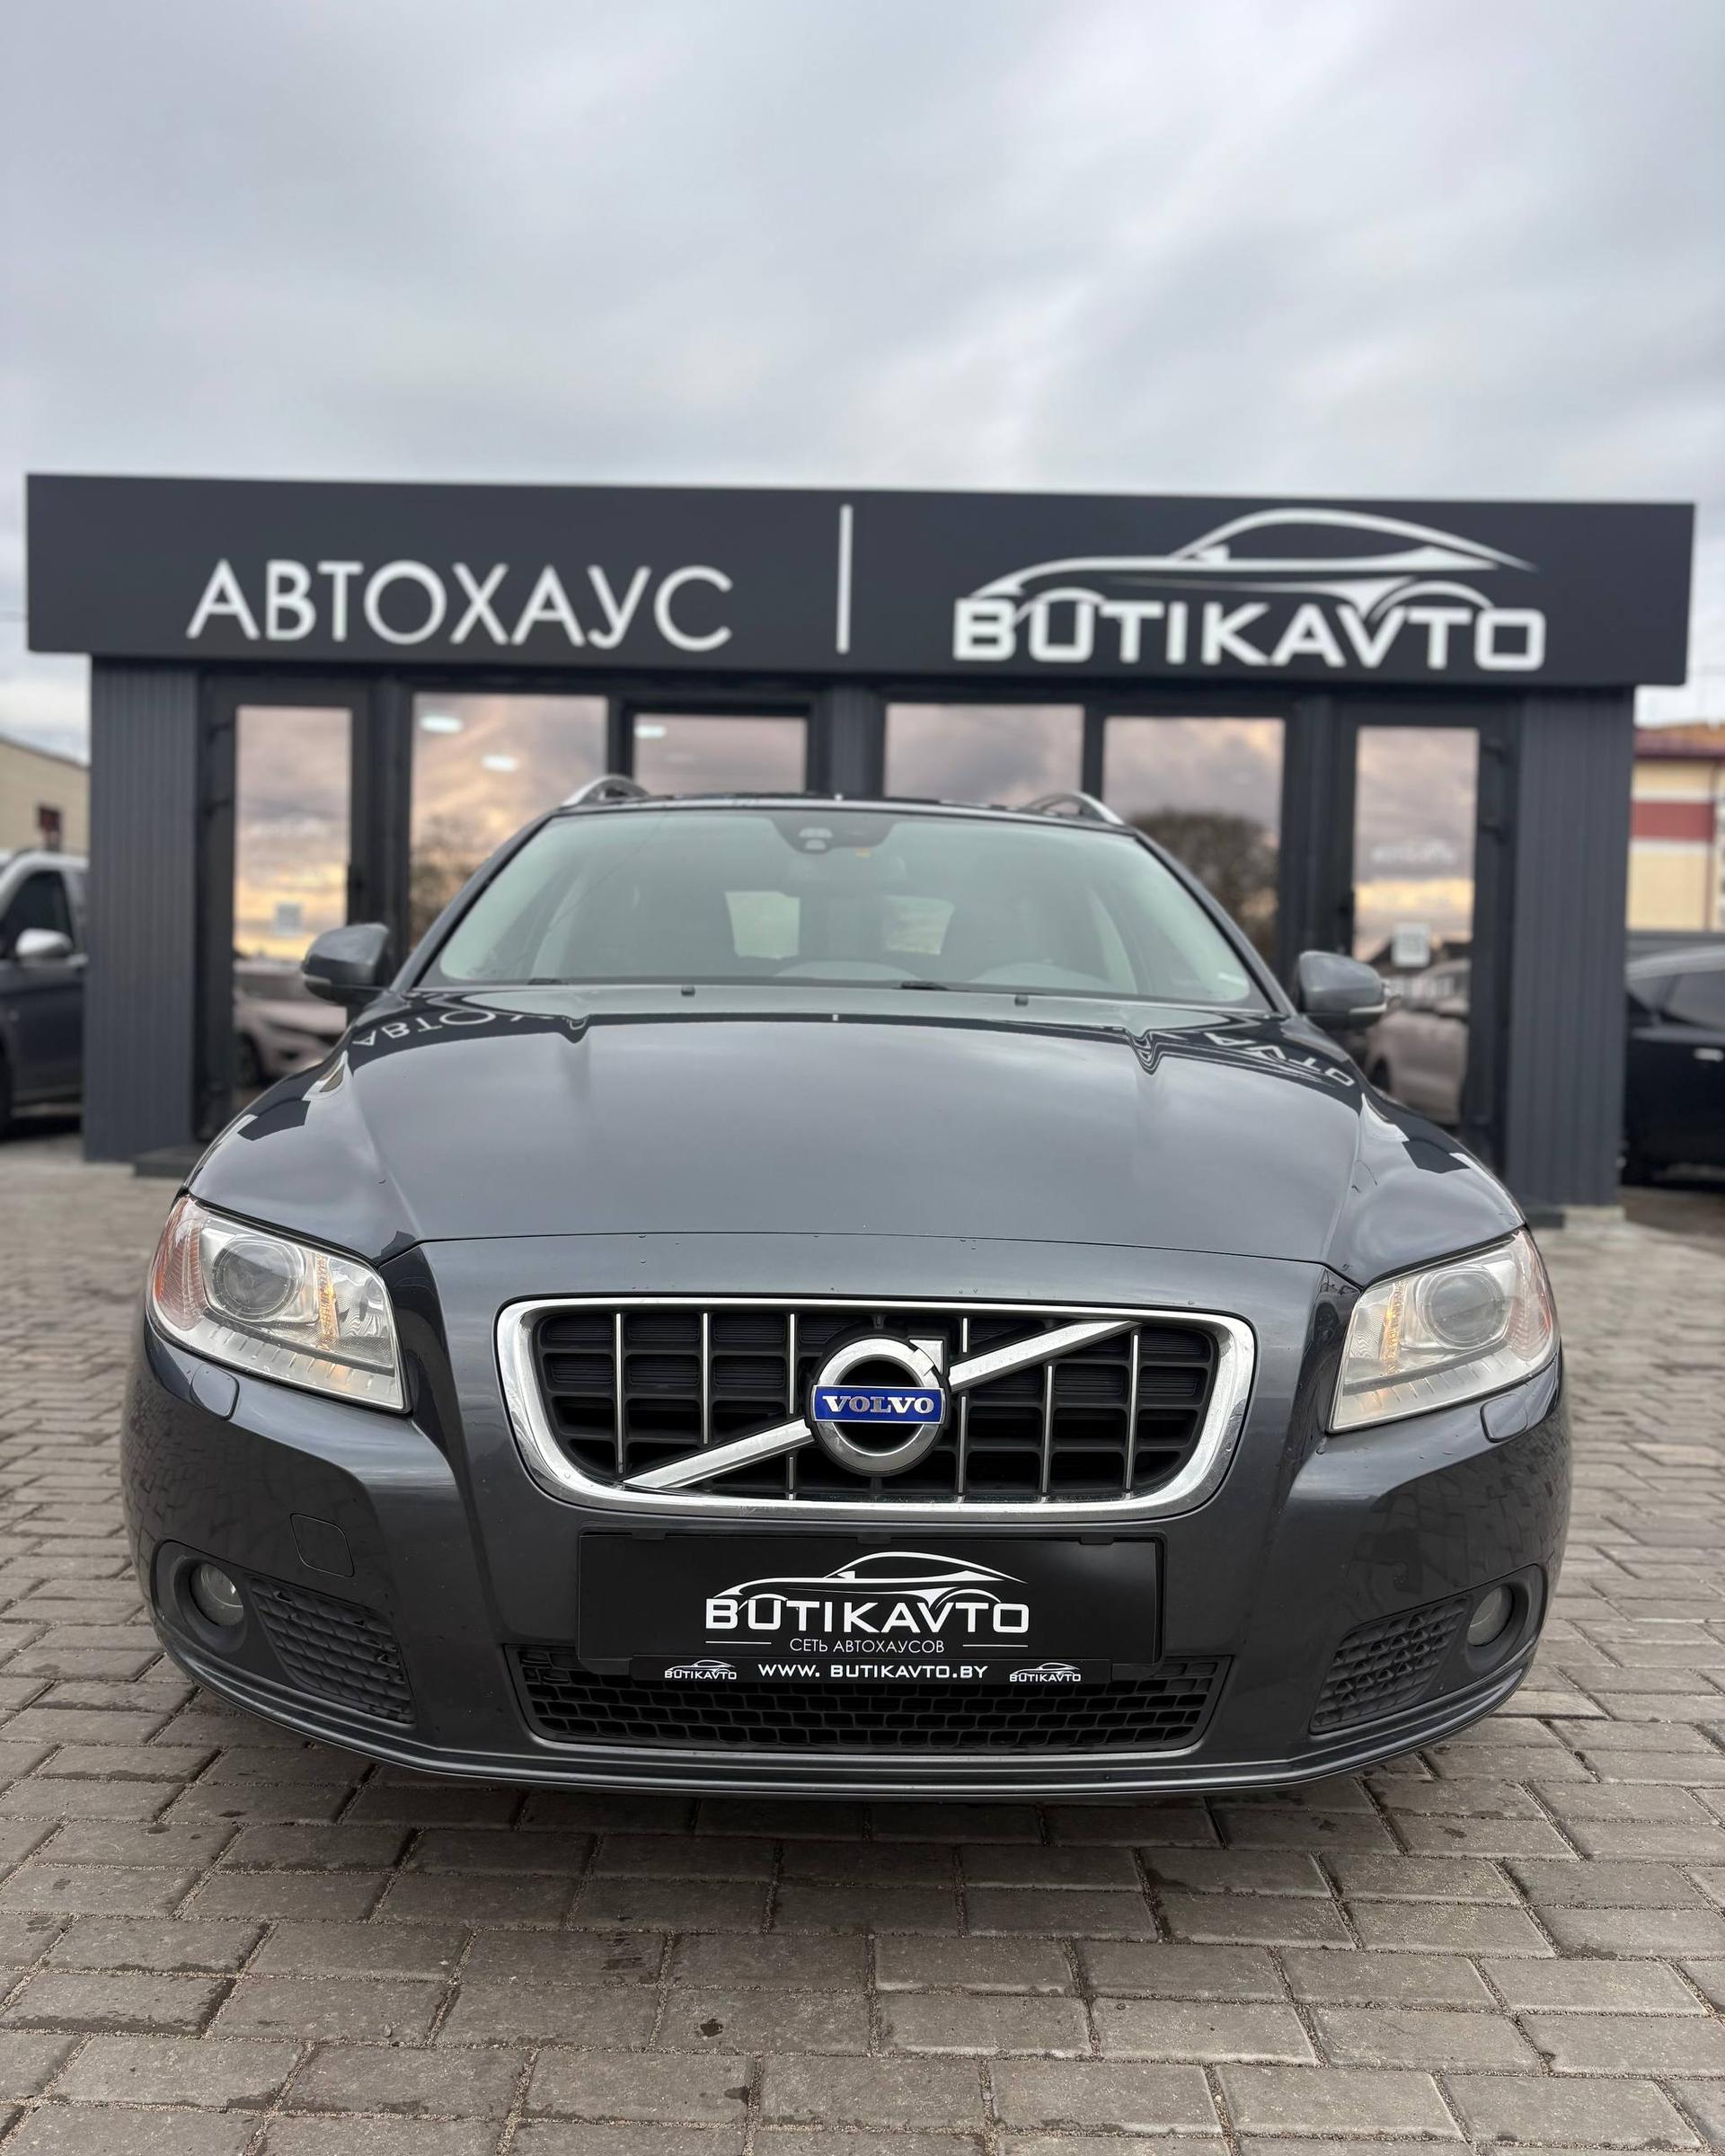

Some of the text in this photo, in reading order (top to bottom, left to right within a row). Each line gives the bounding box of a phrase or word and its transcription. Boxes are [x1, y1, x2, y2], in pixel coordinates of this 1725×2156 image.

[186, 558, 733, 652] АВТОХАУС
[952, 596, 1547, 672] BUTIKAVTO
[822, 1395, 934, 1414] VOLVO
[705, 1598, 1030, 1634] BUTIKAVTO
[790, 1638, 944, 1654] СЕТЬ АВТОХАУСОВ
[664, 1669, 738, 1680] BUTIKAVTO
[1009, 1673, 1082, 1683] BUTIKAVTO
